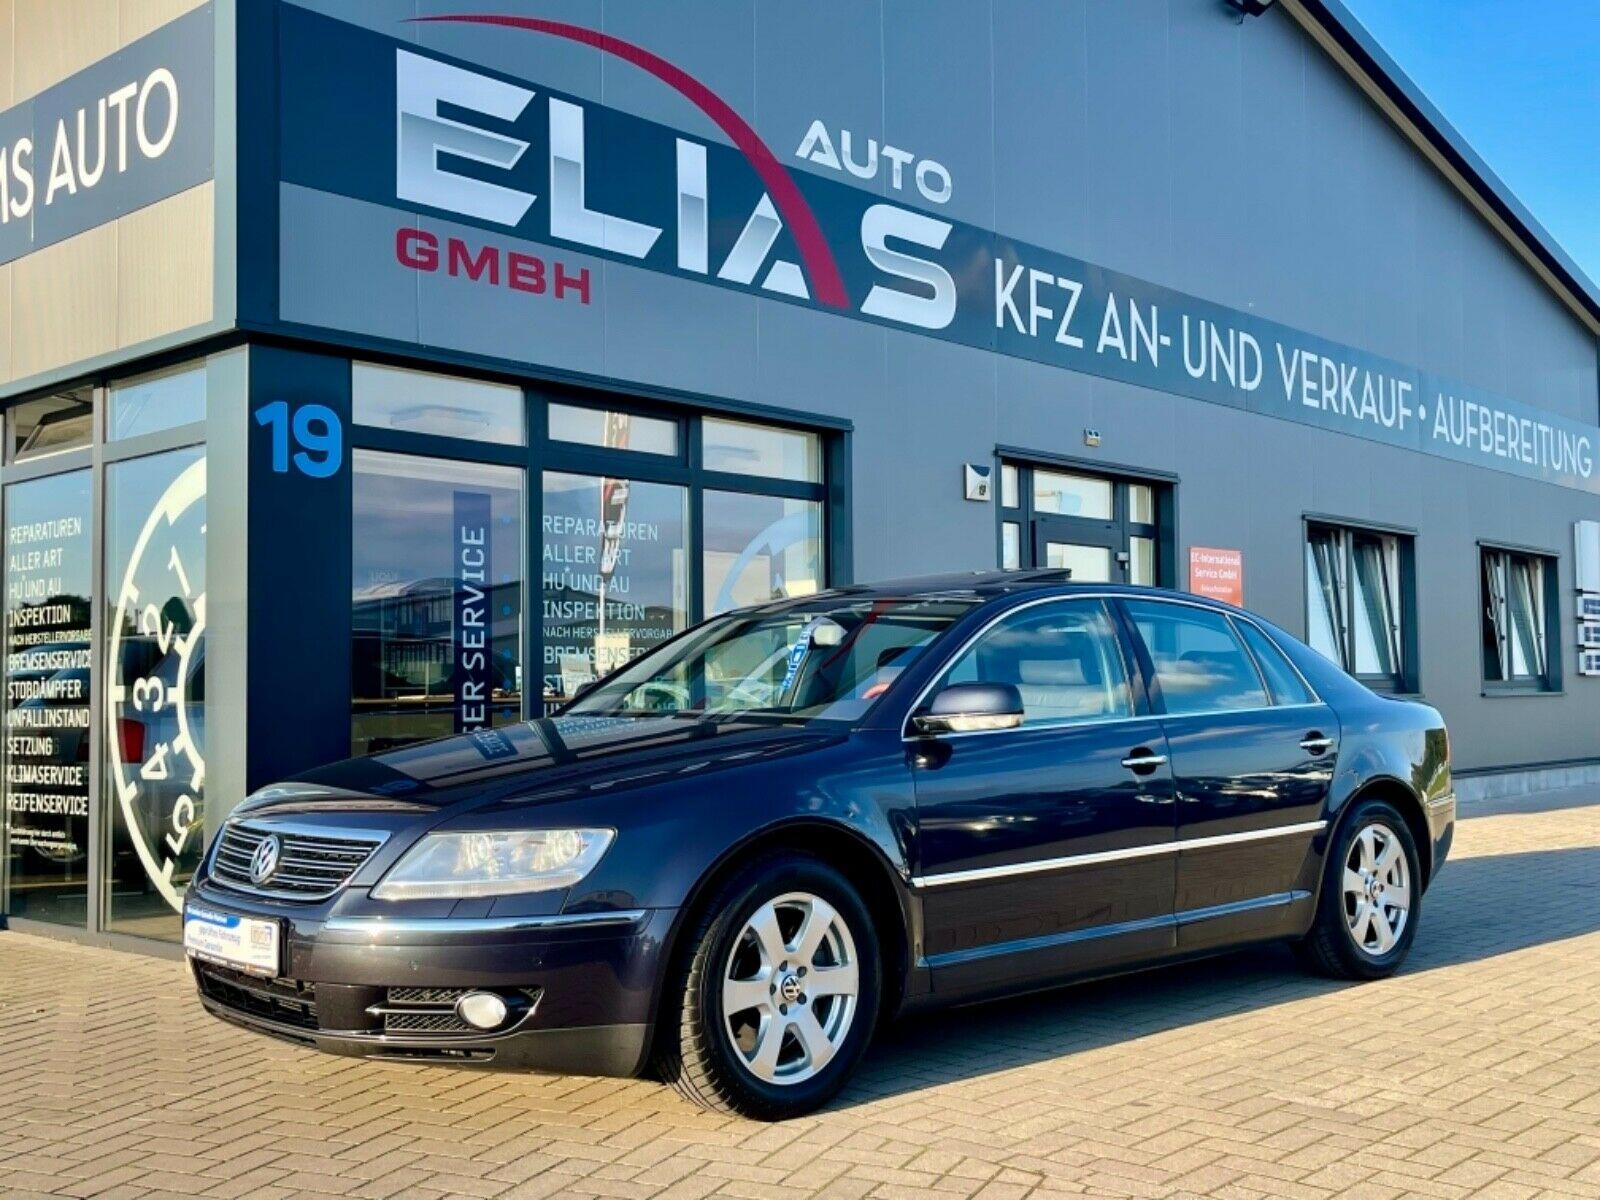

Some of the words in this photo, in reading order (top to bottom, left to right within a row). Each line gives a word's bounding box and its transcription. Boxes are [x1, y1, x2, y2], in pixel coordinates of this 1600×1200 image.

[45, 67, 179, 206] AUTO
[795, 119, 953, 204] AUTO
[396, 47, 957, 330] ELIAS
[396, 228, 591, 305] GMBH
[994, 258, 1083, 349] KFZ
[1097, 292, 1170, 368] AN-
[1181, 314, 1262, 391] UND
[1276, 342, 1413, 431] VERKAUF
[1432, 392, 1594, 479] AUFBEREITUNG
[254, 401, 342, 478] 19
[10, 517, 81, 544] REPARATUREN
[9, 552, 40, 572] ALLER
[44, 548, 63, 567] ART
[543, 544, 596, 564] ALLER
[571, 575, 603, 592] UND
[609, 576, 630, 593] AU
[1195, 568, 1217, 578] Service
[26, 579, 45, 597] UND
[48, 577, 61, 595] AU
[462, 526, 485, 670] SERVICE
[9, 605, 71, 628] INSPEKTION
[143, 603, 174, 655] 2
[543, 627, 571, 638] NACH
[133, 676, 164, 712] 3
[8, 709, 90, 727] UNFALLINSTAND
[7, 737, 53, 756] SETZUNG
[140, 742, 169, 780] 4
[7, 766, 83, 785] KLIMASERVICE
[7, 794, 88, 816] REIFENSERVICE
[166, 794, 195, 856] 5
